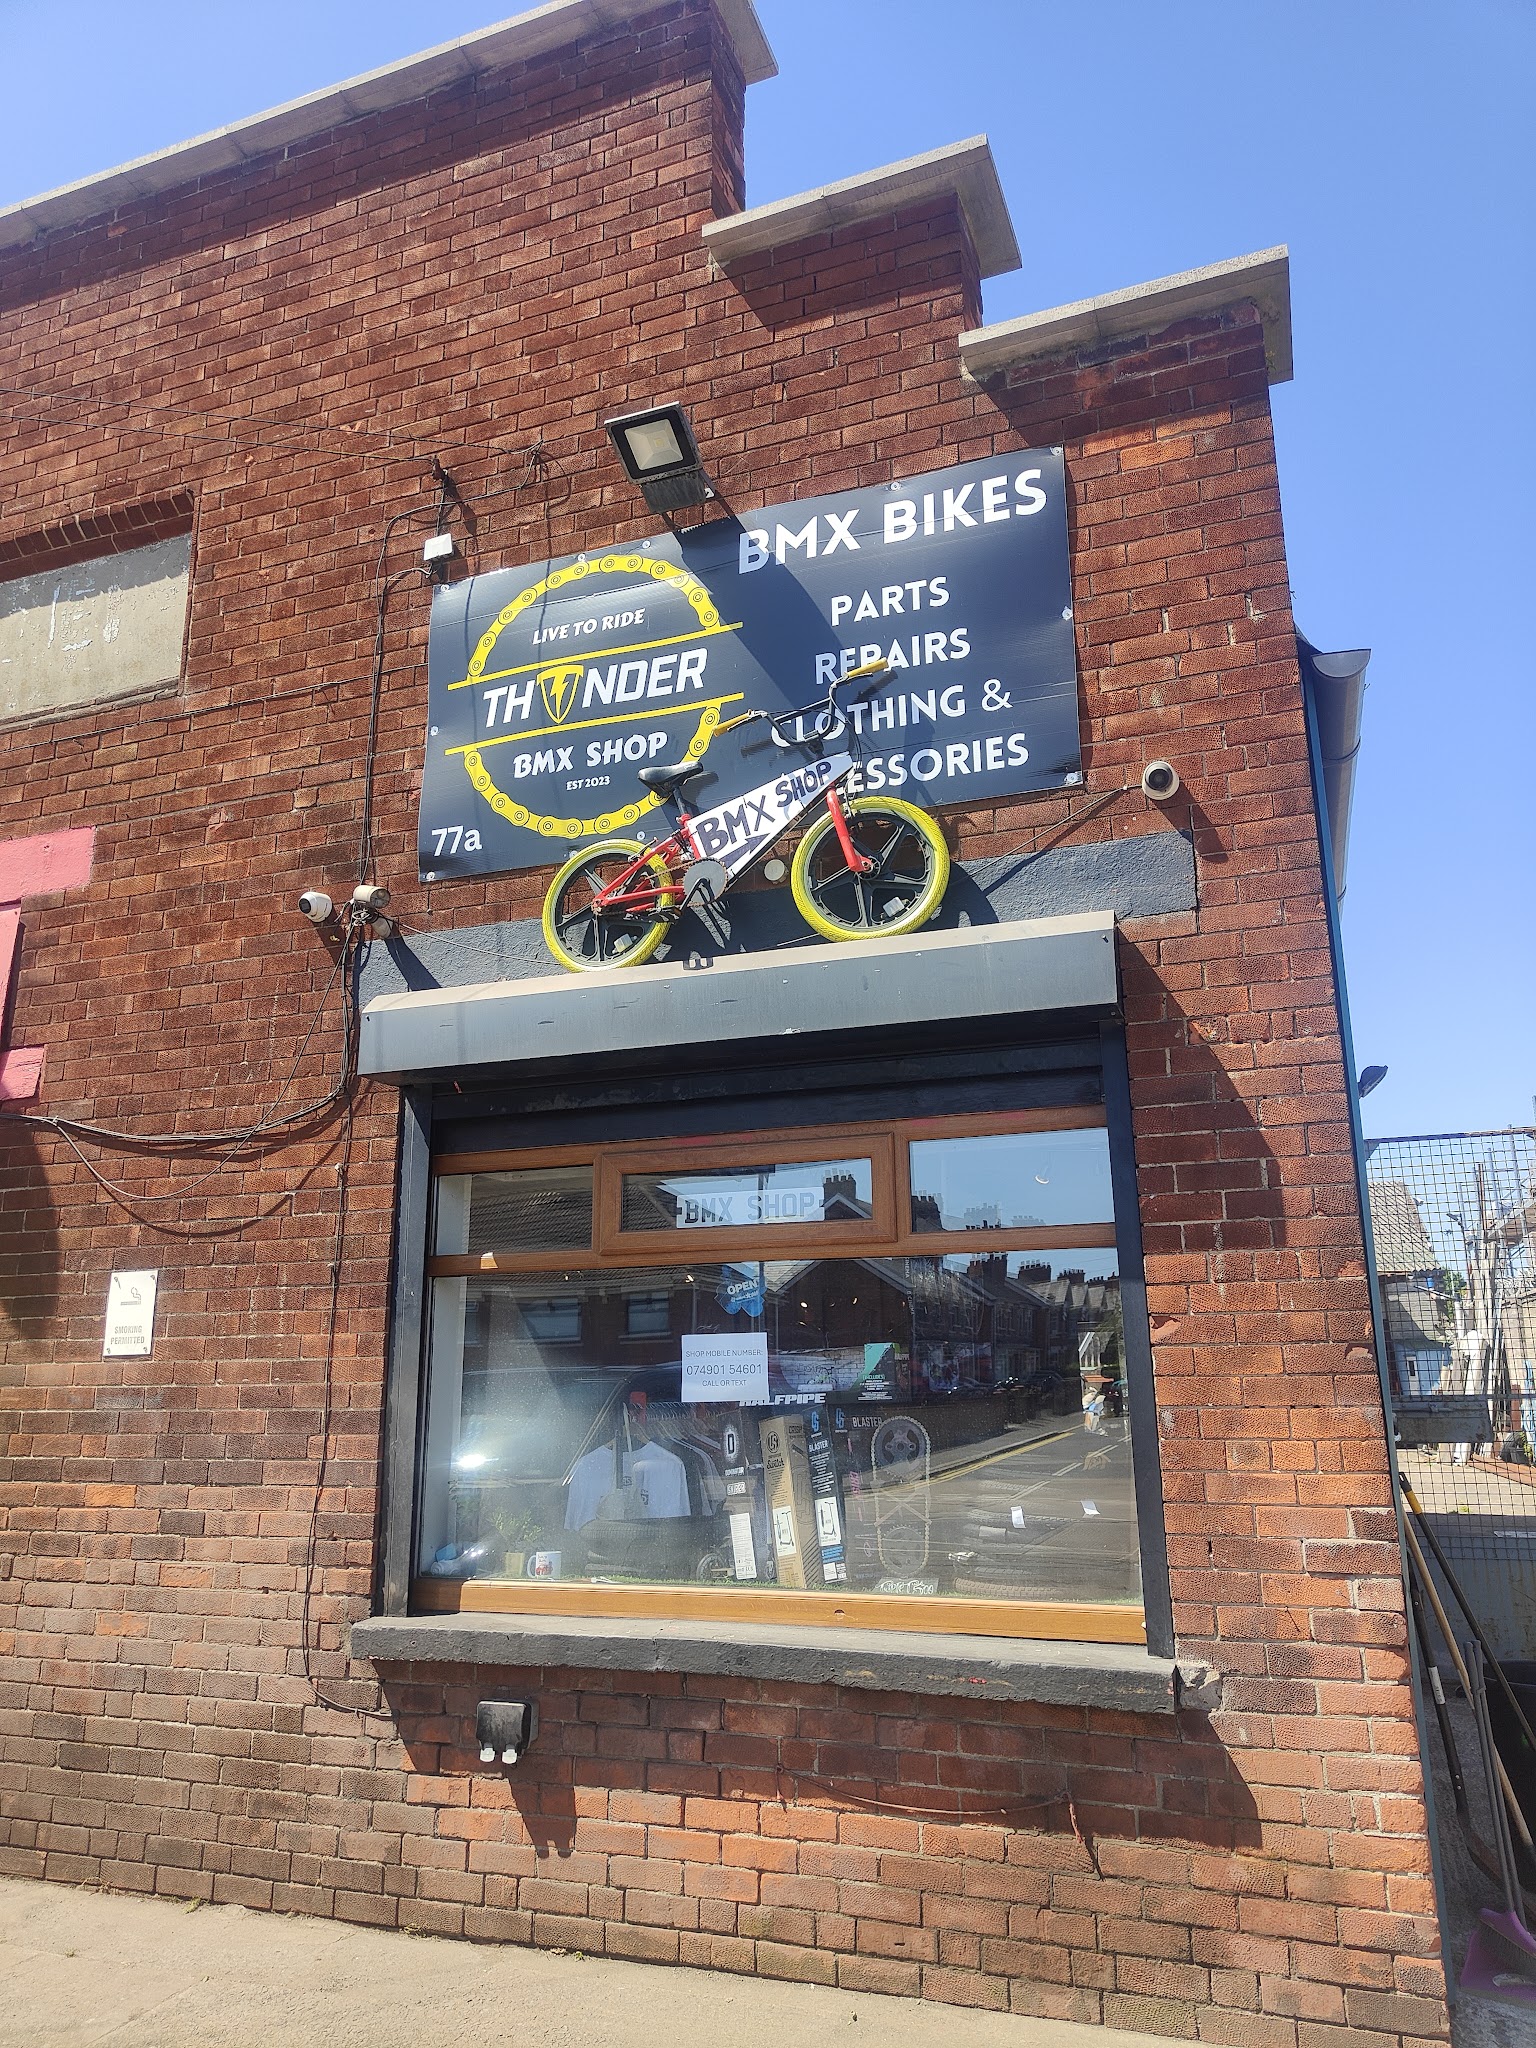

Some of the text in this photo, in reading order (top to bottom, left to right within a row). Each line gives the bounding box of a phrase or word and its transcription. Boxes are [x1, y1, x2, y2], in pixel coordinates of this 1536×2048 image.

[738, 469, 1047, 574] BMX BIKES
[831, 576, 950, 627] PARTS
[532, 608, 646, 645] LIVE TO RIDE
[815, 627, 971, 685] REPAIRS
[981, 679, 1013, 712] &
[513, 732, 668, 779] BMX SHOP
[836, 732, 1029, 796] ESSORIES
[566, 776, 610, 791] EST 2023
[696, 761, 832, 856] BMX SHOP
[431, 825, 483, 857] 77a
[684, 1192, 815, 1224] BMX SHOP
[727, 1279, 759, 1296] OPEN
[110, 1335, 145, 1345] PERMITTED
[114, 1325, 143, 1335] SMOKING
[685, 1350, 704, 1358] SHOP
[686, 1363, 762, 1376] 074901 54601
[702, 1379, 747, 1387] CALL OR TEXT
[808, 1440, 829, 1453] BLASTER
